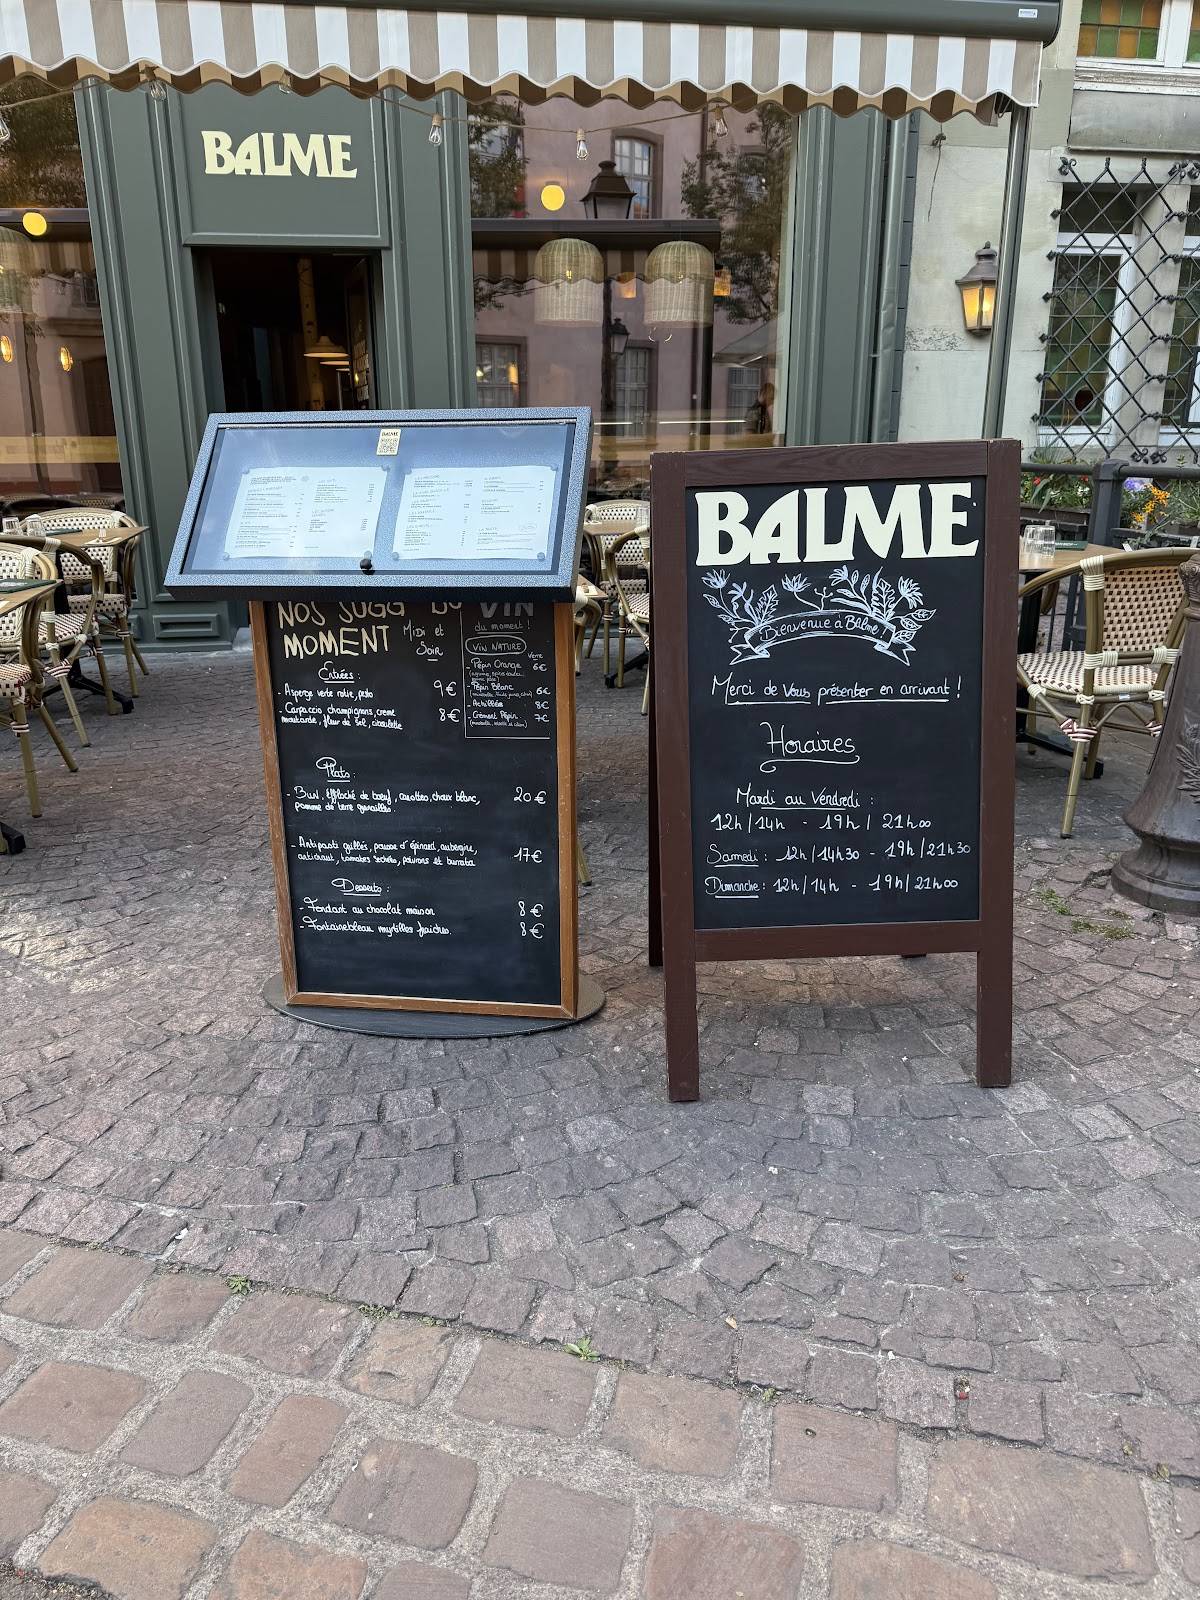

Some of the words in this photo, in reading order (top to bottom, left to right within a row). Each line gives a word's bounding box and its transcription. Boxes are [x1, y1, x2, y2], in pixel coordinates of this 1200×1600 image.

[201, 130, 358, 178] BALME
[695, 482, 979, 566] BALME
[278, 601, 325, 629] NOS
[760, 618, 832, 641] Bienvenue
[834, 613, 844, 629] à
[283, 625, 390, 660] MOMENT
[491, 642, 522, 652] NATURE
[494, 659, 522, 674] Orange
[285, 682, 314, 703] Asperge
[316, 688, 333, 697] verte
[491, 682, 514, 690] Blanc
[711, 672, 756, 705] Merci
[763, 680, 779, 696] de
[816, 682, 874, 706] présenter
[878, 683, 894, 695] en
[898, 678, 951, 696] arrivant
[759, 721, 856, 757] Horaires
[359, 790, 370, 800] de
[736, 782, 776, 808] Mardi
[784, 794, 807, 806] au
[810, 786, 861, 809] Vendredi
[337, 802, 355, 812] terre
[298, 835, 340, 853] Antipasti
[303, 896, 348, 915] Fondant
[351, 904, 365, 915] au
[365, 902, 402, 916] chocolat
[405, 904, 436, 916] maison
[302, 915, 375, 933] Fontainebleau
[377, 923, 414, 938] myrtilles
